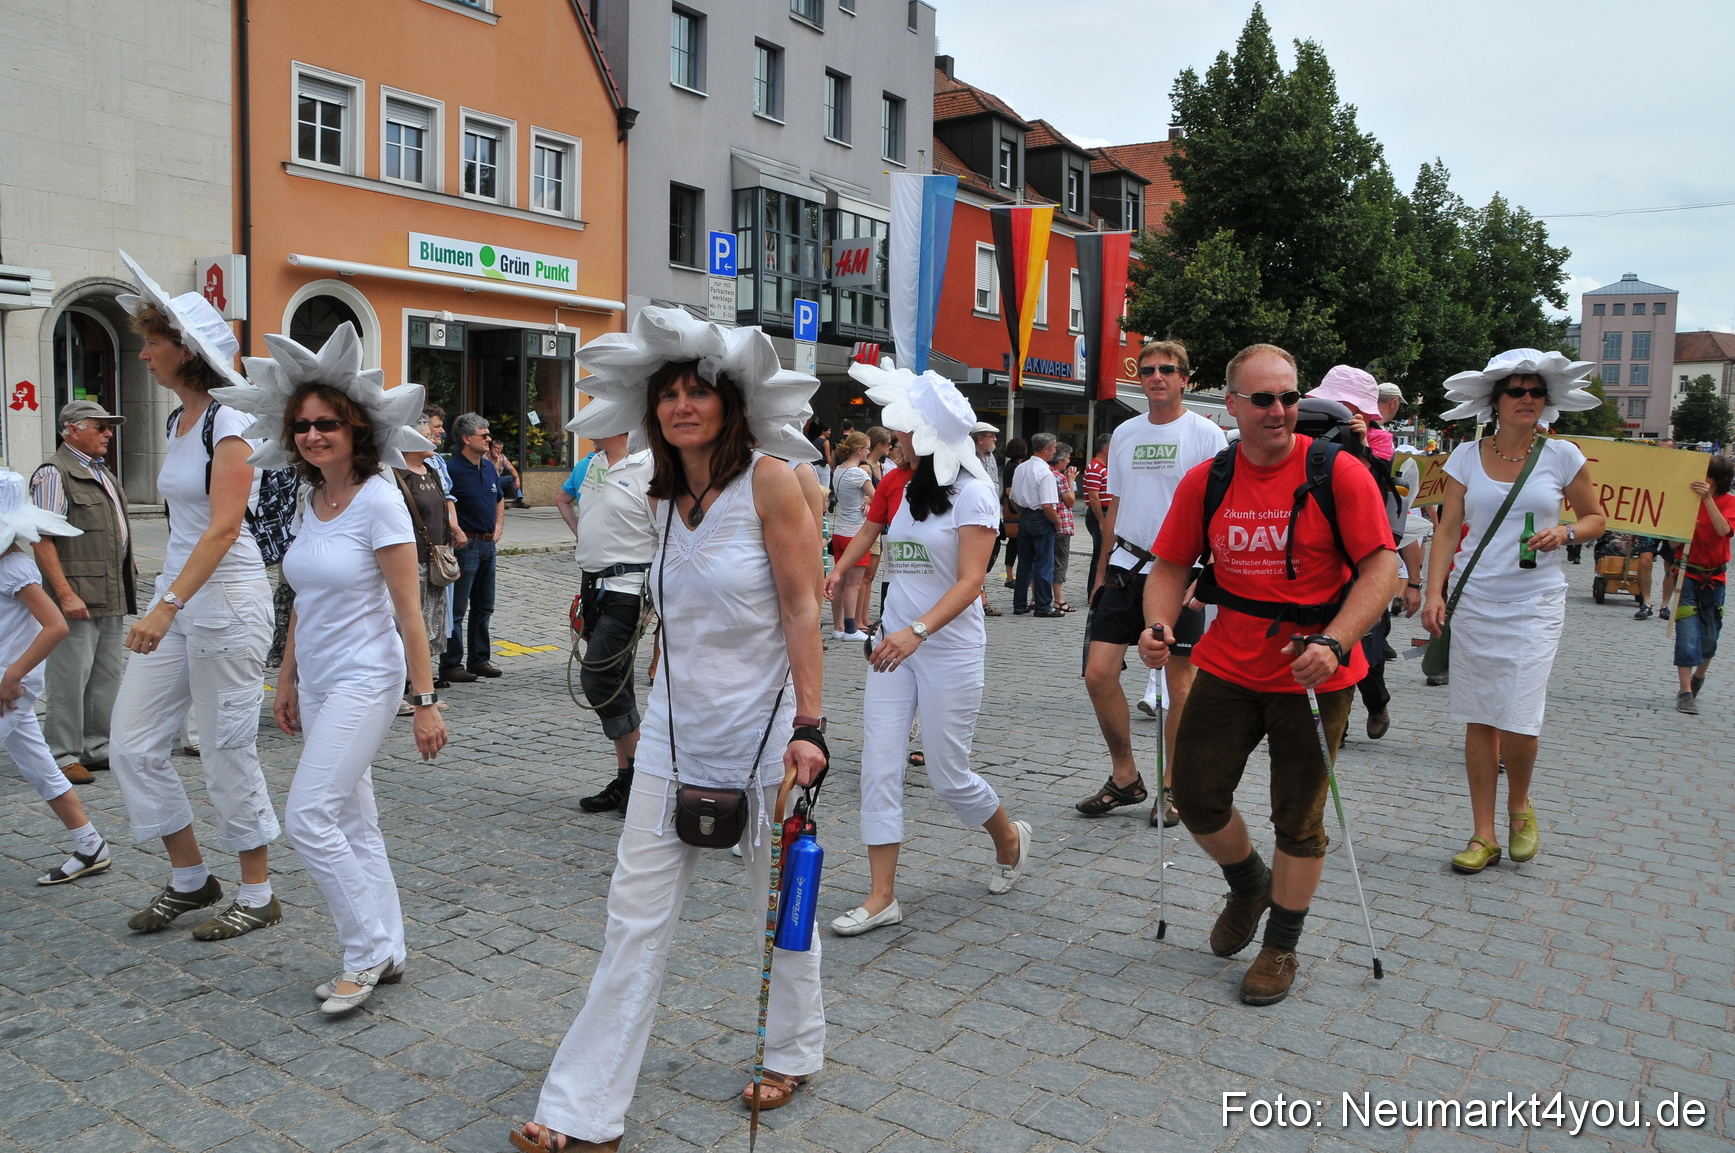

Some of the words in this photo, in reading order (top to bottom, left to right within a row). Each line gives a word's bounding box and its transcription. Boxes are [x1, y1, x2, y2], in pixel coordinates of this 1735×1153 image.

[420, 241, 473, 267] Blumen
[500, 254, 530, 276] Grün
[535, 260, 570, 283] Punkt
[715, 237, 731, 270] P
[835, 247, 871, 277] H&M
[710, 286, 735, 296] Parkschein
[712, 295, 733, 304] werktags
[799, 305, 813, 335] P
[1146, 446, 1176, 459] DAV
[903, 543, 928, 560] DAV
[1228, 525, 1289, 552] DAV
[1231, 558, 1261, 566] Deutscher
[1262, 558, 1300, 567] Alpenveein
[794, 887, 803, 926] DUNLOP
